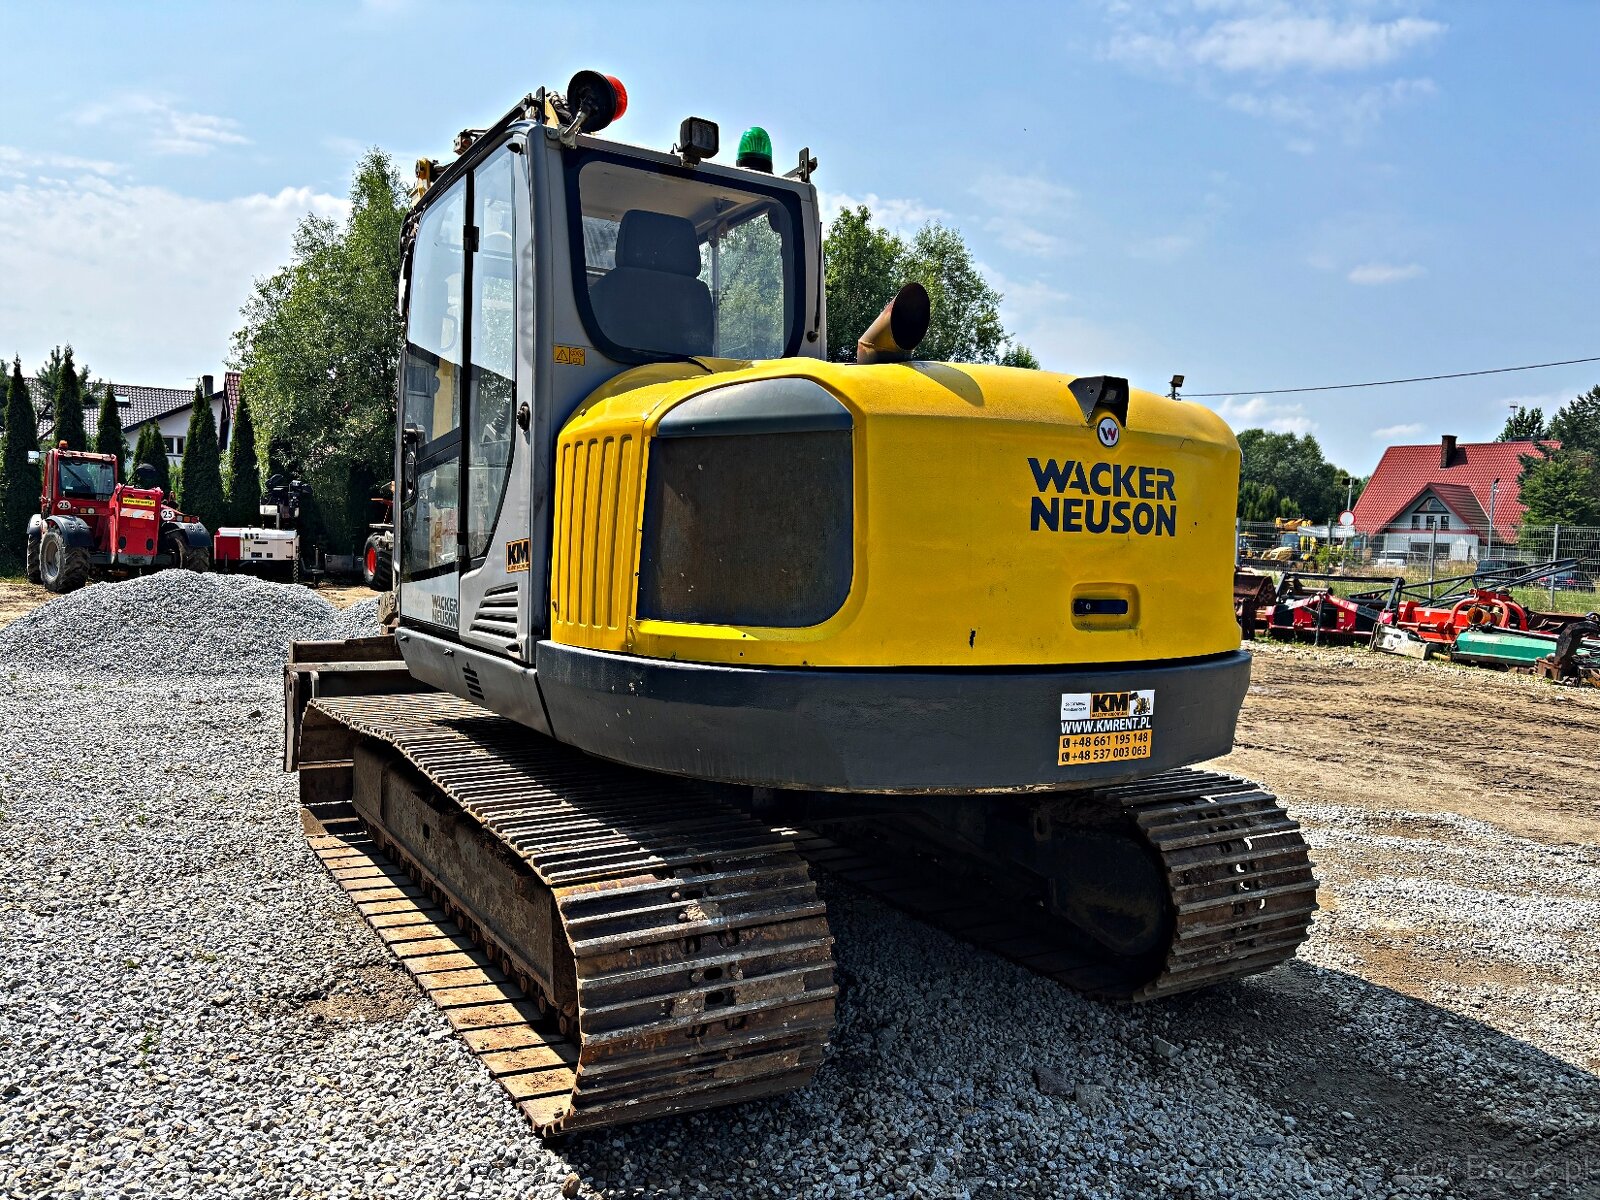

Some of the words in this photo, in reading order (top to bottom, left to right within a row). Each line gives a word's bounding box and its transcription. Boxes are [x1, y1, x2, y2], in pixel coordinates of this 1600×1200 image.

[1027, 457, 1177, 501] WACKER
[162, 510, 173, 519] 25
[1030, 496, 1177, 537] NEUSON
[508, 541, 529, 565] KM
[1093, 694, 1129, 712] KM
[1061, 717, 1151, 734] WWW.KMRENT.PL
[1072, 737, 1091, 748] +48
[1093, 735, 1111, 747] 661
[1114, 733, 1131, 744] 195
[1133, 732, 1148, 743] 148
[1071, 750, 1091, 761] +48
[1093, 748, 1111, 760] 537
[1112, 747, 1130, 758] 003
[1131, 745, 1147, 756] 063
